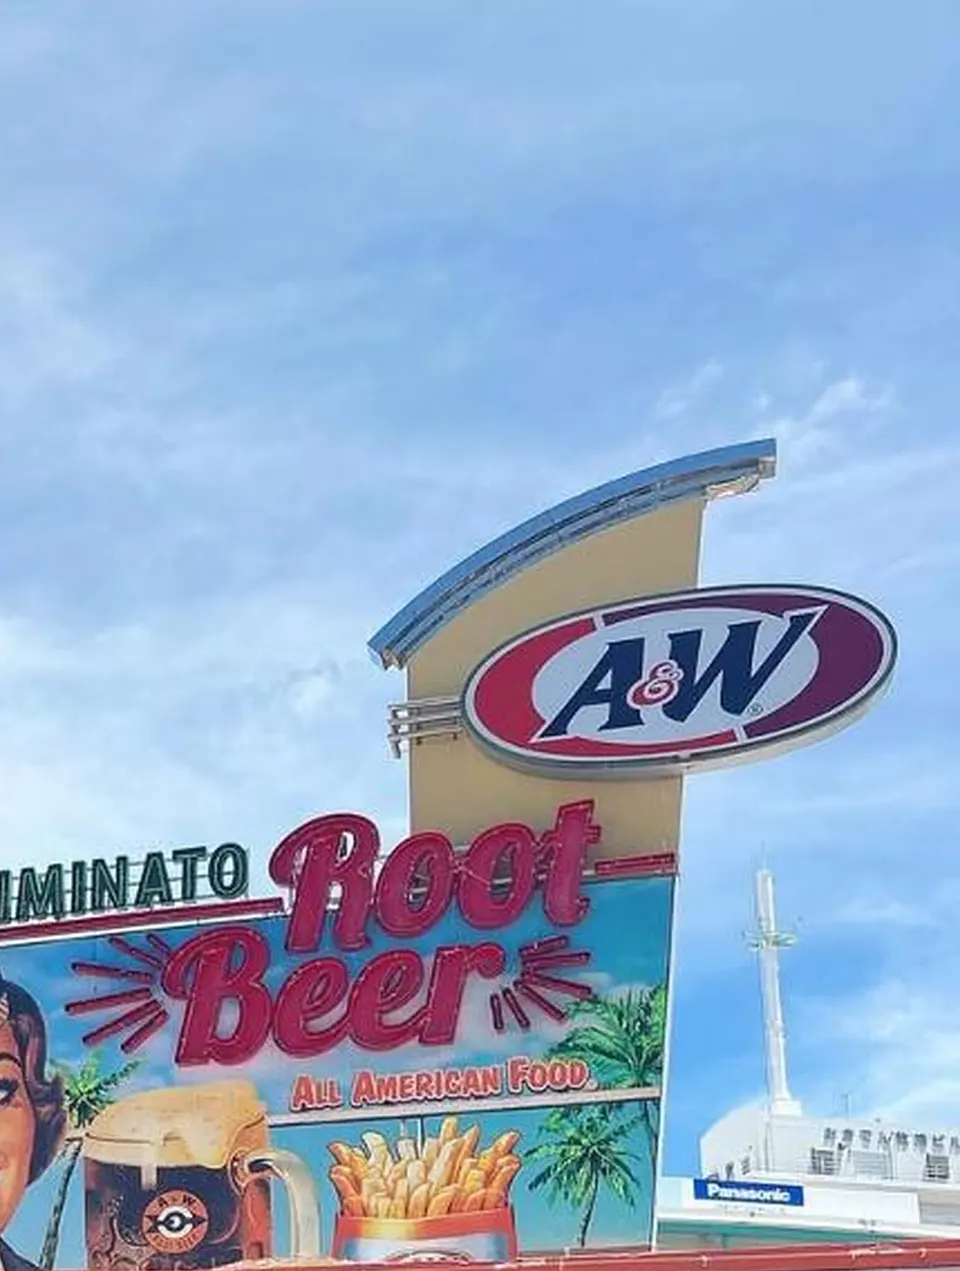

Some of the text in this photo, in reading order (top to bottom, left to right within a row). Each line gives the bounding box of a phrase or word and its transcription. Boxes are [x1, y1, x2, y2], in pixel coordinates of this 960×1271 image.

[532, 602, 825, 740] A&W
[268, 798, 602, 952] Root
[160, 926, 506, 1067] Beer
[350, 1066, 502, 1106] AMERICAN
[707, 1182, 791, 1202] Panasonic
